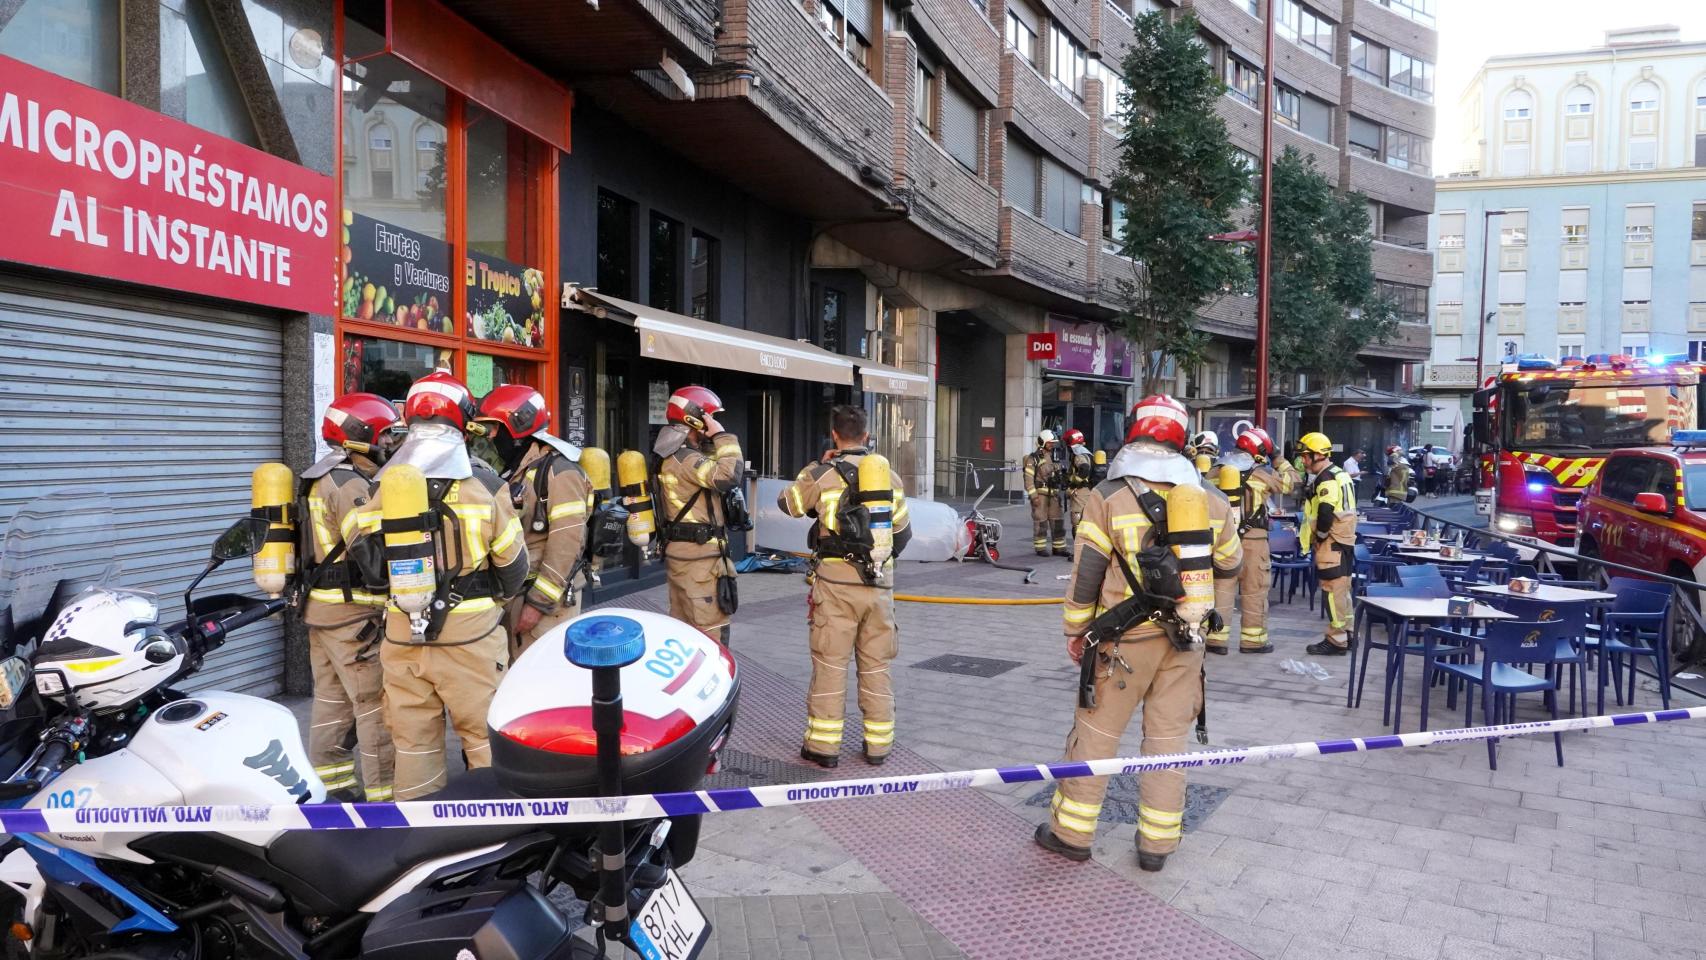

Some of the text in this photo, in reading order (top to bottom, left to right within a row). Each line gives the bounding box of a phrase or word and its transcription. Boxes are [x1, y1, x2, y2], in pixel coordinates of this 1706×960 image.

[0, 92, 328, 238] MICROPRÉSTAMOS
[50, 189, 290, 286] AL INSTANTE
[376, 224, 420, 260] Frutas
[394, 262, 449, 293] y Verduras
[466, 258, 520, 297] El Tropico
[645, 638, 694, 678] 092
[787, 781, 919, 800] AYTO. VALLADOLID
[76, 806, 213, 823] AYTO. VALLADOLID
[433, 801, 569, 818] AYTO. VALLADOLID
[58, 833, 97, 843] Kawasaki
[644, 878, 680, 940] 8717
[659, 920, 694, 960] KHL
